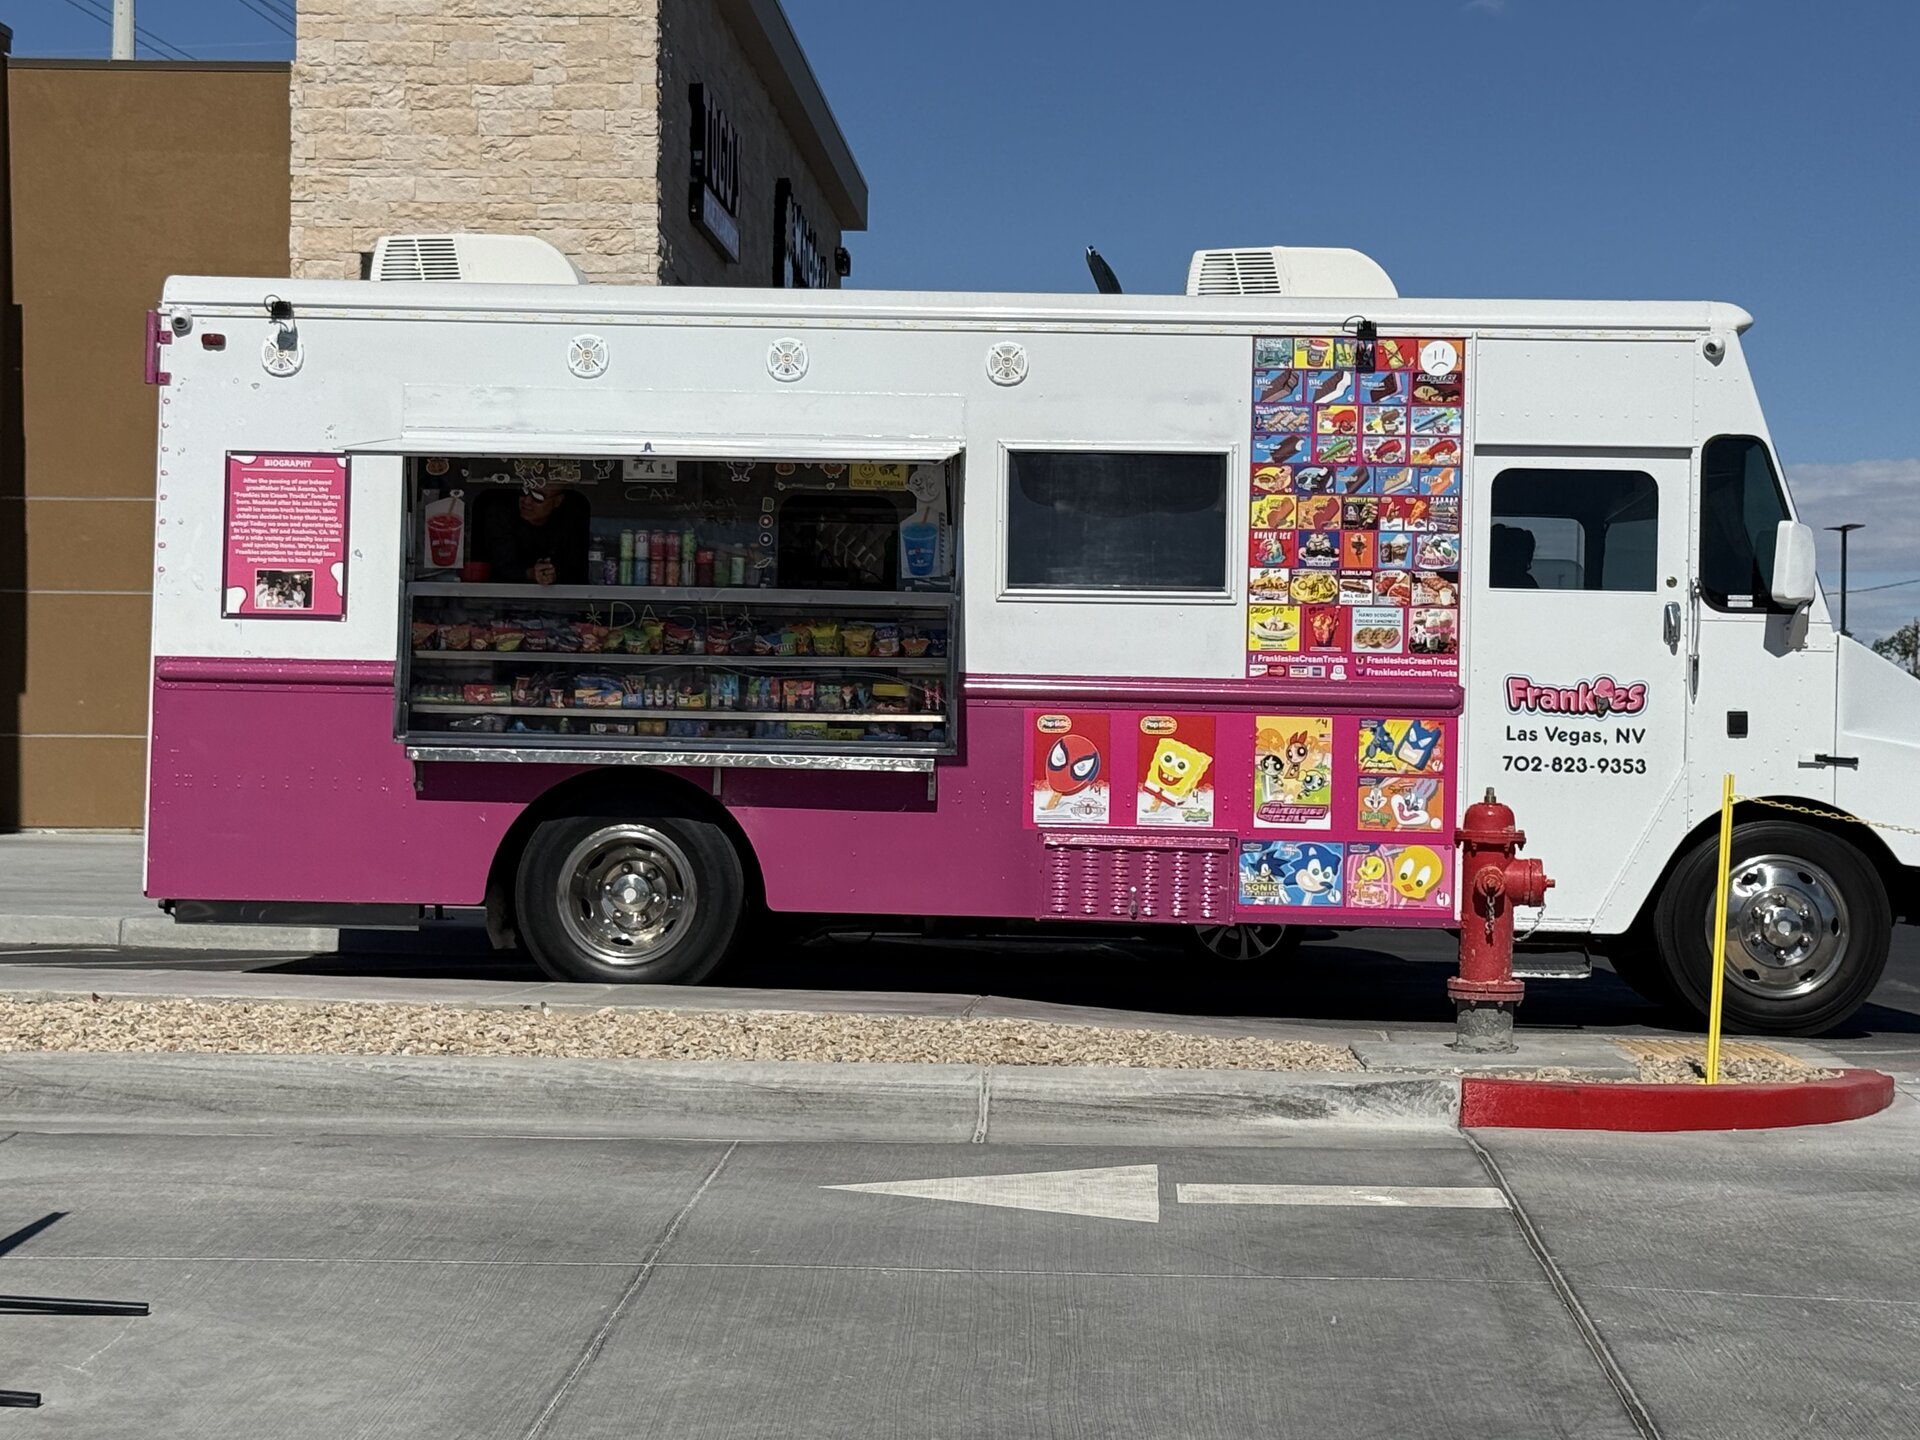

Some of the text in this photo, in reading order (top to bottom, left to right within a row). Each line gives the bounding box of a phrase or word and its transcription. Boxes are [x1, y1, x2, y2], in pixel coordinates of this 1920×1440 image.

[264, 459, 312, 467] BIOGRAPHY
[1258, 654, 1348, 664] FrankiesIceCreamTrucks
[1366, 656, 1457, 666] FrankiesIceCreamTrucks
[1366, 668, 1457, 678] FrankiesIceCreamTrucks
[1506, 676, 1646, 716] Frankies
[1506, 726, 1646, 746] Las Vegas, NV
[1502, 756, 1646, 774] 702-823-9353
[1245, 883, 1278, 892] SONIC
